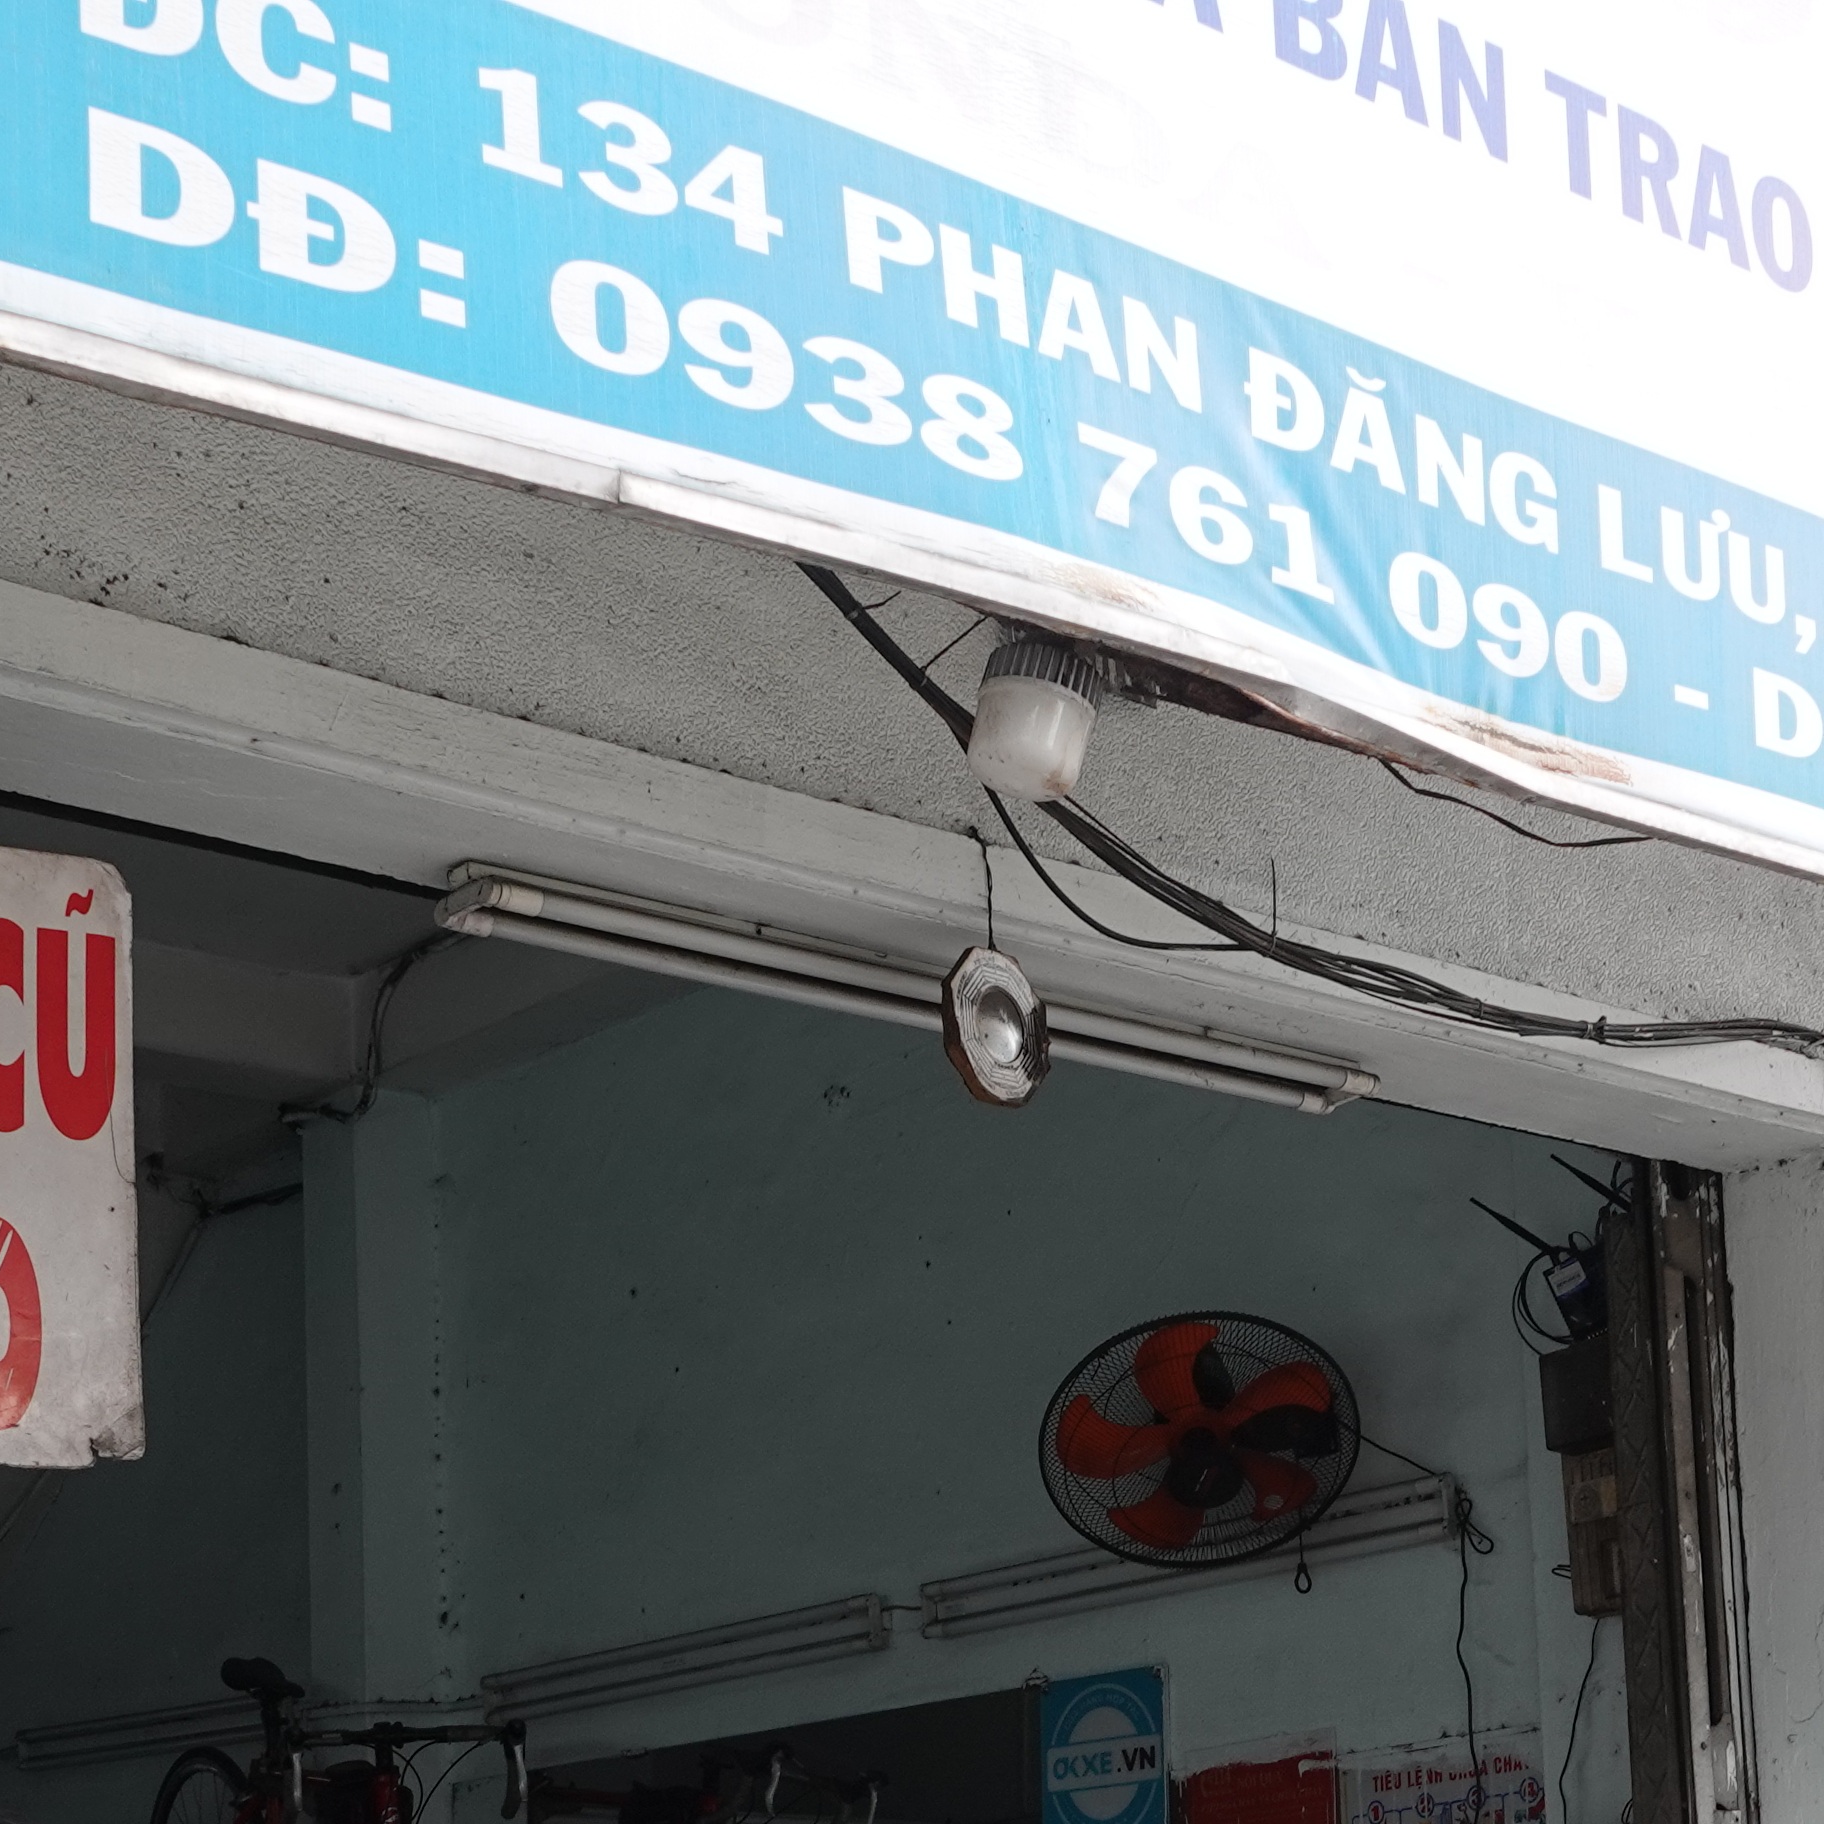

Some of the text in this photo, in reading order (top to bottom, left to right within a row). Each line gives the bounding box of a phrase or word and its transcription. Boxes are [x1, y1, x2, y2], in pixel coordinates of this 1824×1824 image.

[87, 107, 468, 329] DĐ:
[549, 259, 1026, 483] 0938
[1076, 423, 1337, 605] 761
[1388, 549, 1627, 703] 090
[477, 66, 782, 255] 134
[841, 184, 1203, 413] PHAN
[1243, 365, 1559, 554] ĐĂNG
[1597, 481, 1817, 657] LƯU,
[1543, 67, 1814, 294] TRAO
